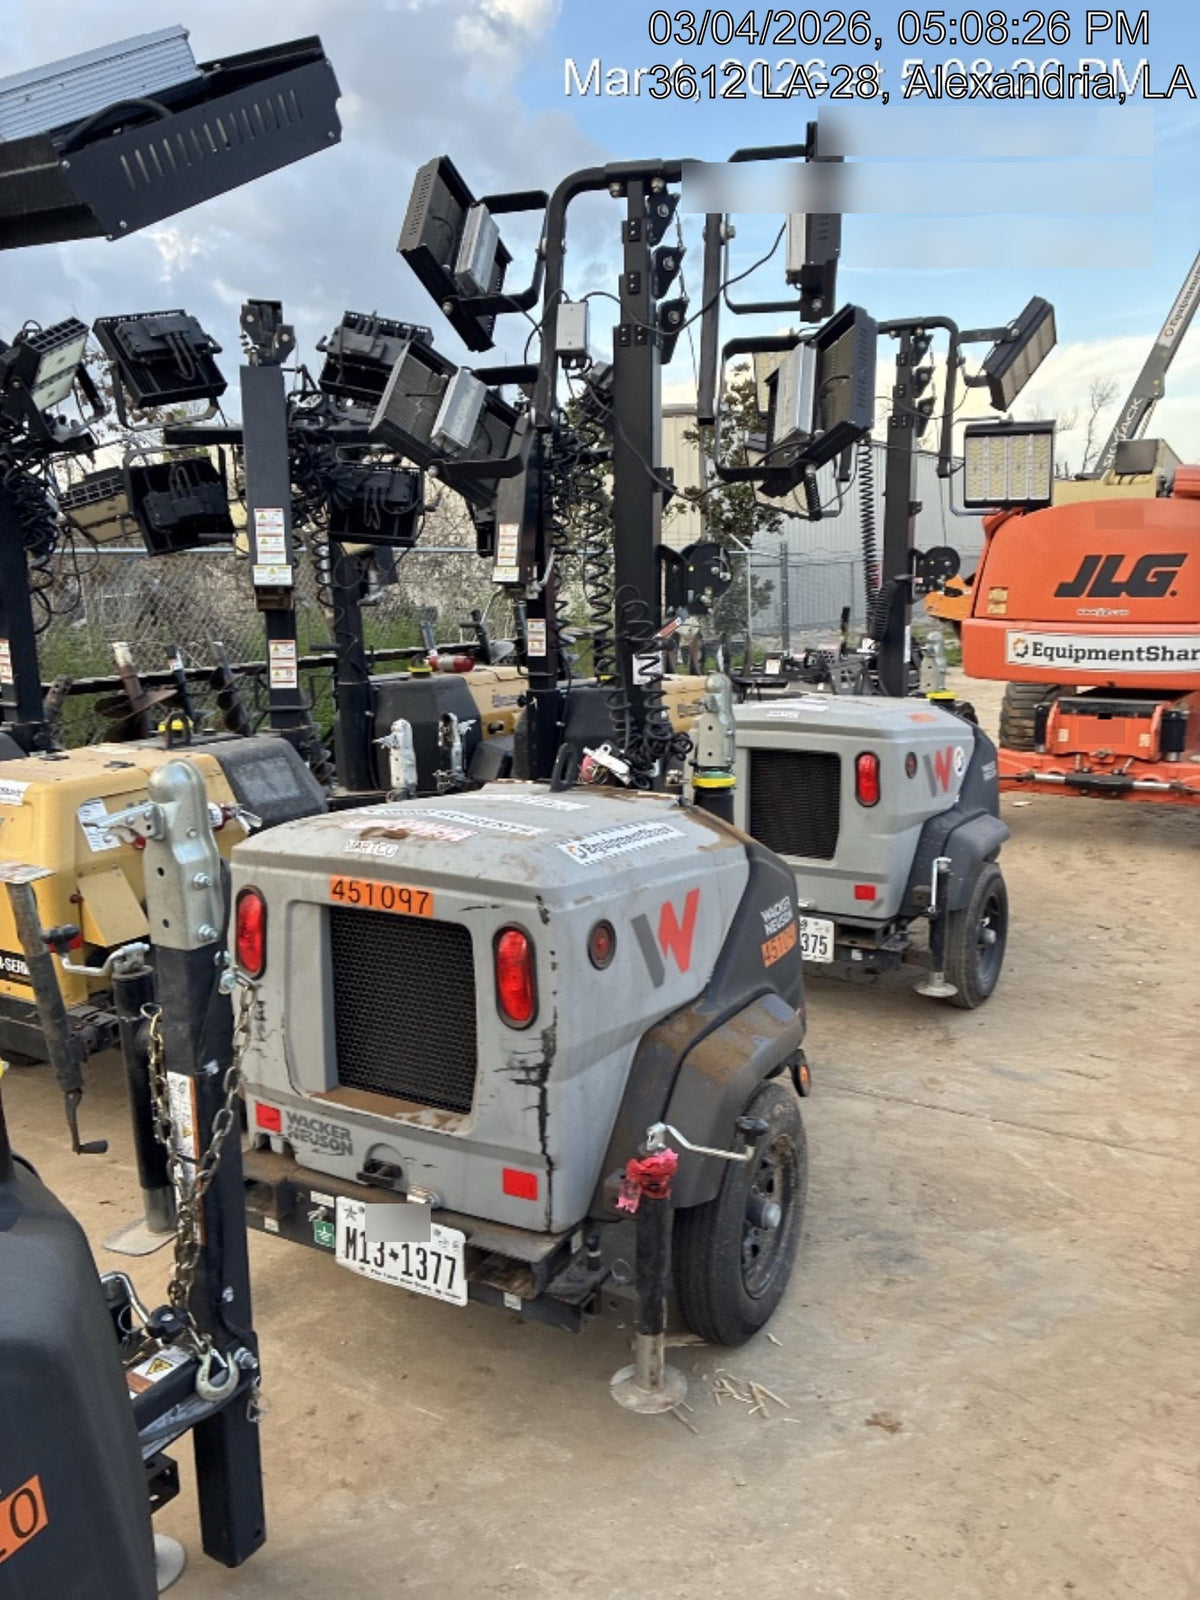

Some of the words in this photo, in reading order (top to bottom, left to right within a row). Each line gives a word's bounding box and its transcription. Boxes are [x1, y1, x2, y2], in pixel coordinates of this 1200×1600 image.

[332, 879, 430, 915] 451097
[801, 933, 828, 955] 375
[286, 1110, 352, 1142] WACKER
[287, 1125, 354, 1156] NEUSON
